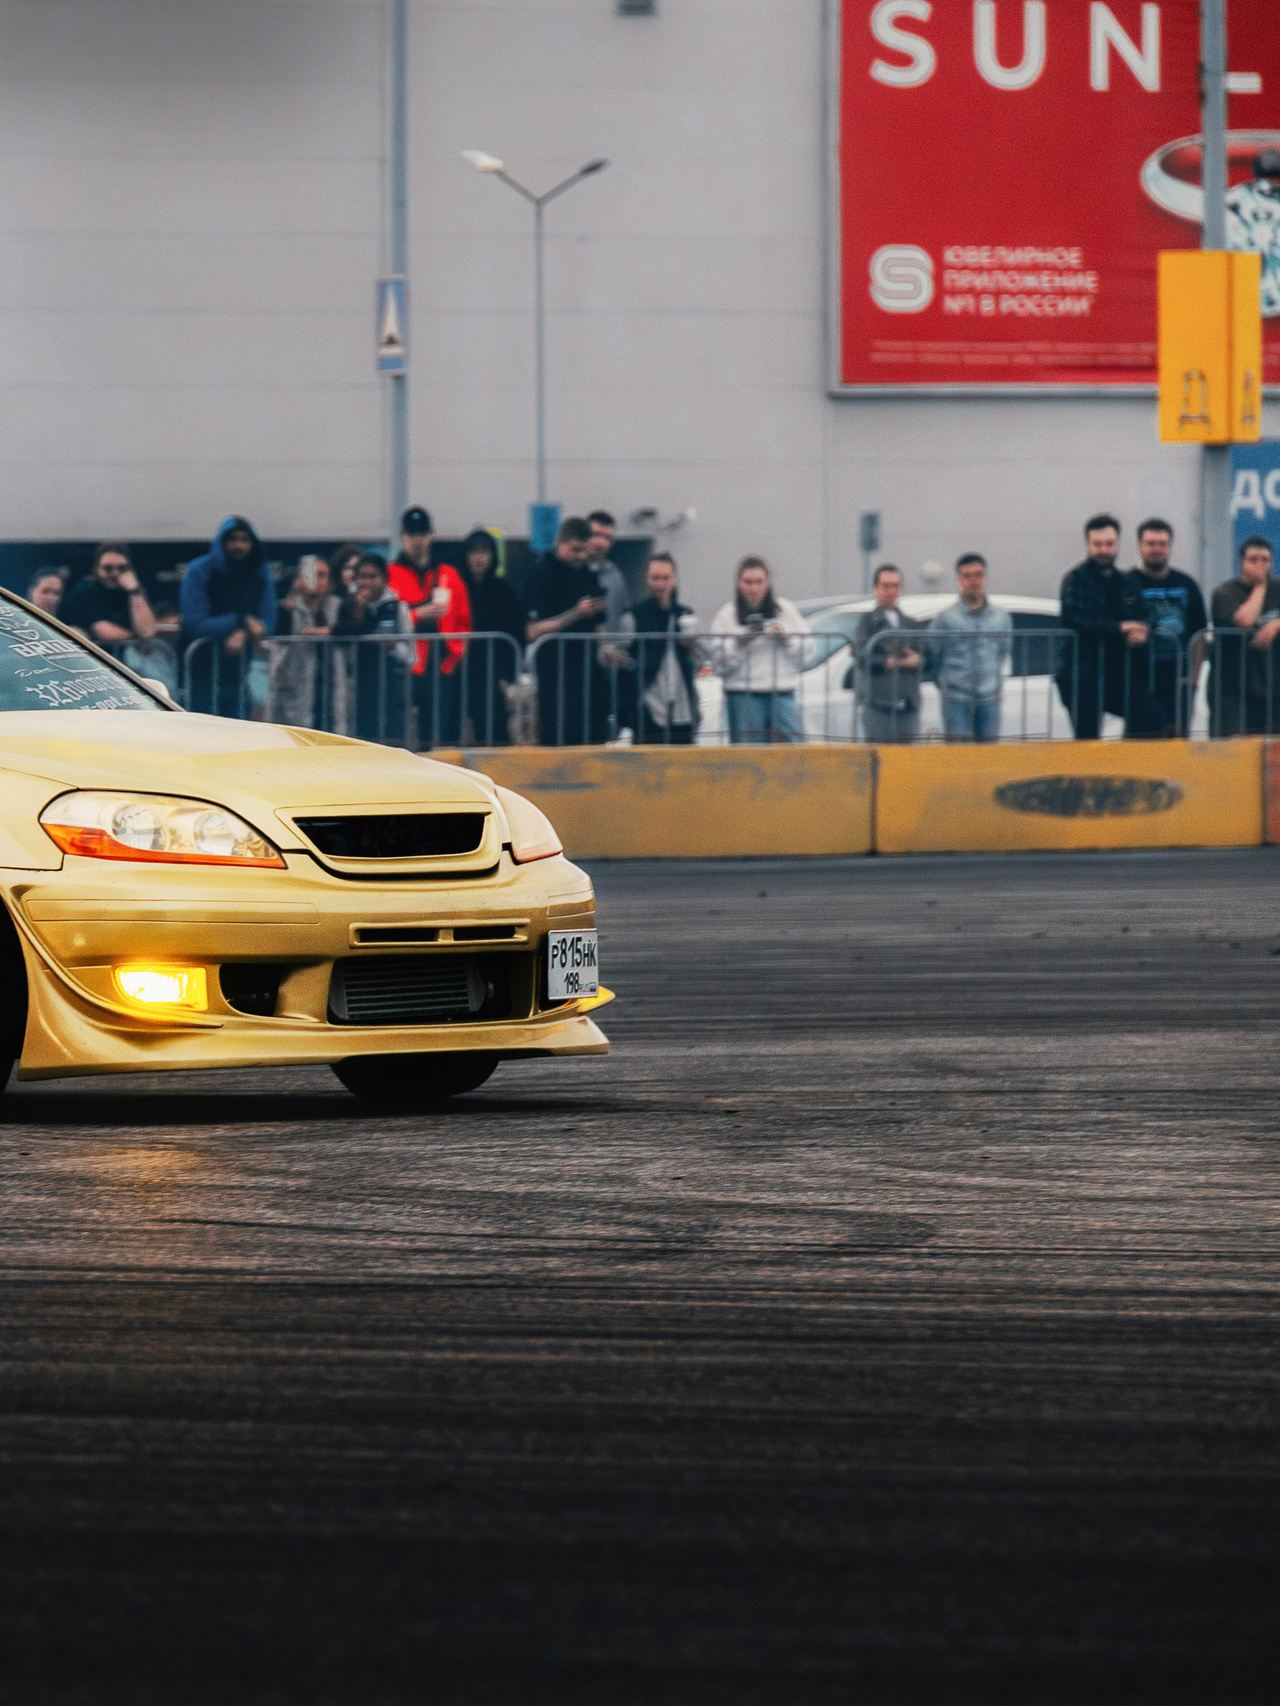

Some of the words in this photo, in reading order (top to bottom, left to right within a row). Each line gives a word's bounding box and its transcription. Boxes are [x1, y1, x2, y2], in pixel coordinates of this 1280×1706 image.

[943, 269, 1099, 293] ПРИЛОЖЕНИЕ
[1000, 295, 1091, 318] РОССИИ
[564, 971, 580, 994] 198
